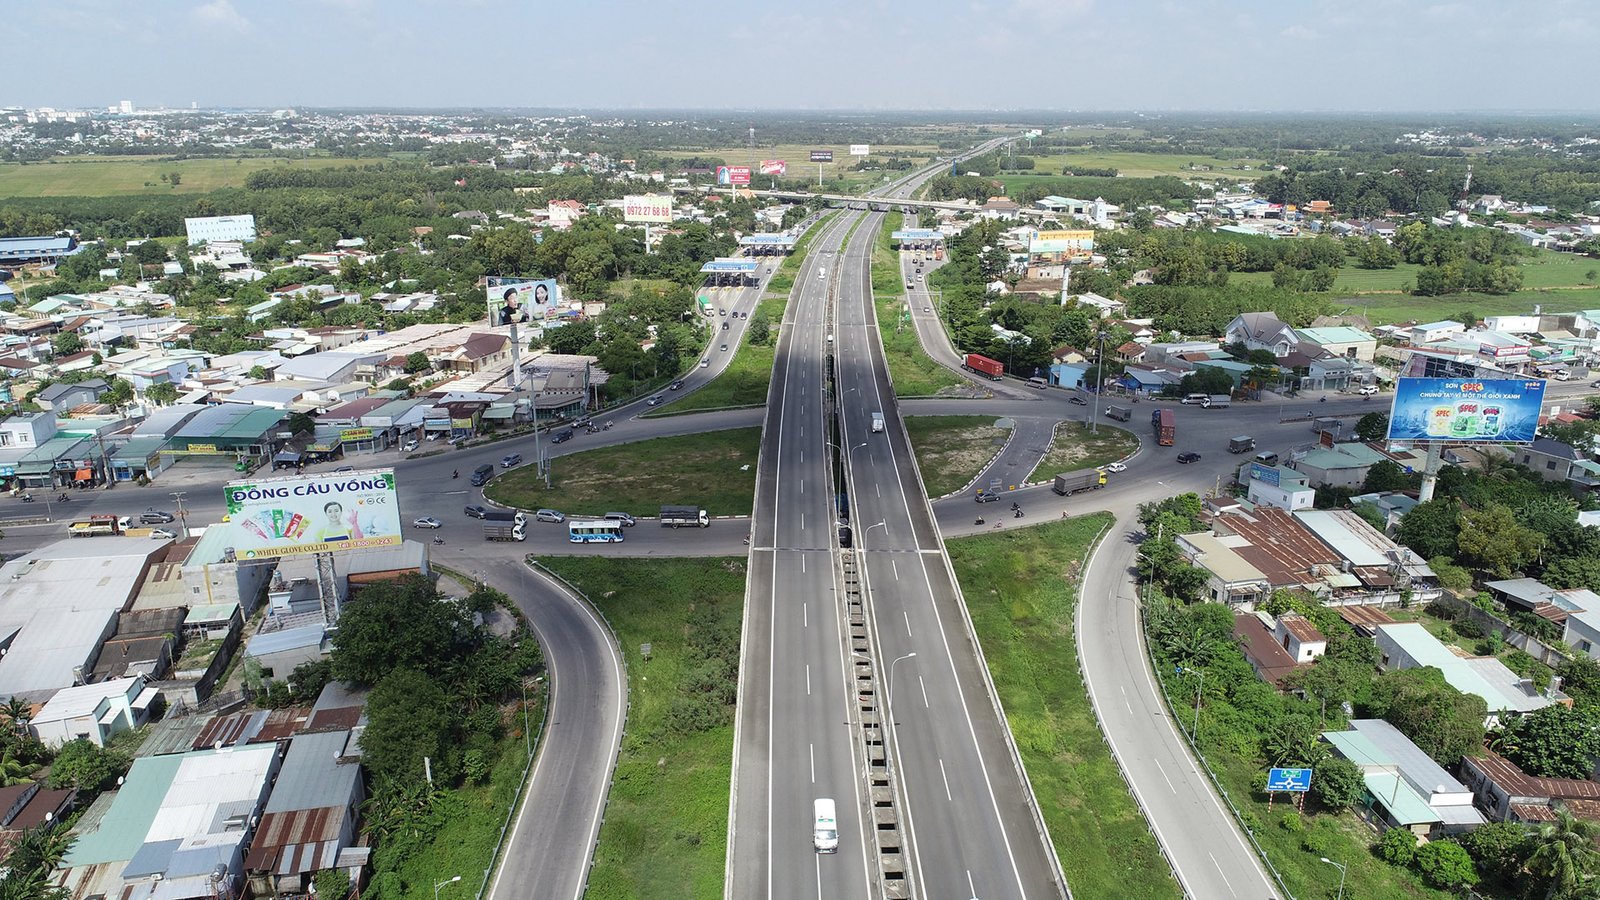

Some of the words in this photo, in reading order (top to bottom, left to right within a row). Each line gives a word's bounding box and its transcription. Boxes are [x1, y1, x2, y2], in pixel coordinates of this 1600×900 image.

[627, 206, 642, 215] 0972
[643, 206, 650, 215] 27
[652, 207, 660, 216] 68
[662, 207, 669, 216] 68
[1462, 383, 1481, 391] SPEC
[1458, 404, 1477, 413] SPEC
[233, 488, 289, 501] ĐÔNG
[293, 482, 330, 496] CẦU
[256, 548, 280, 556] WHITE
[280, 546, 303, 554] GLOVE
